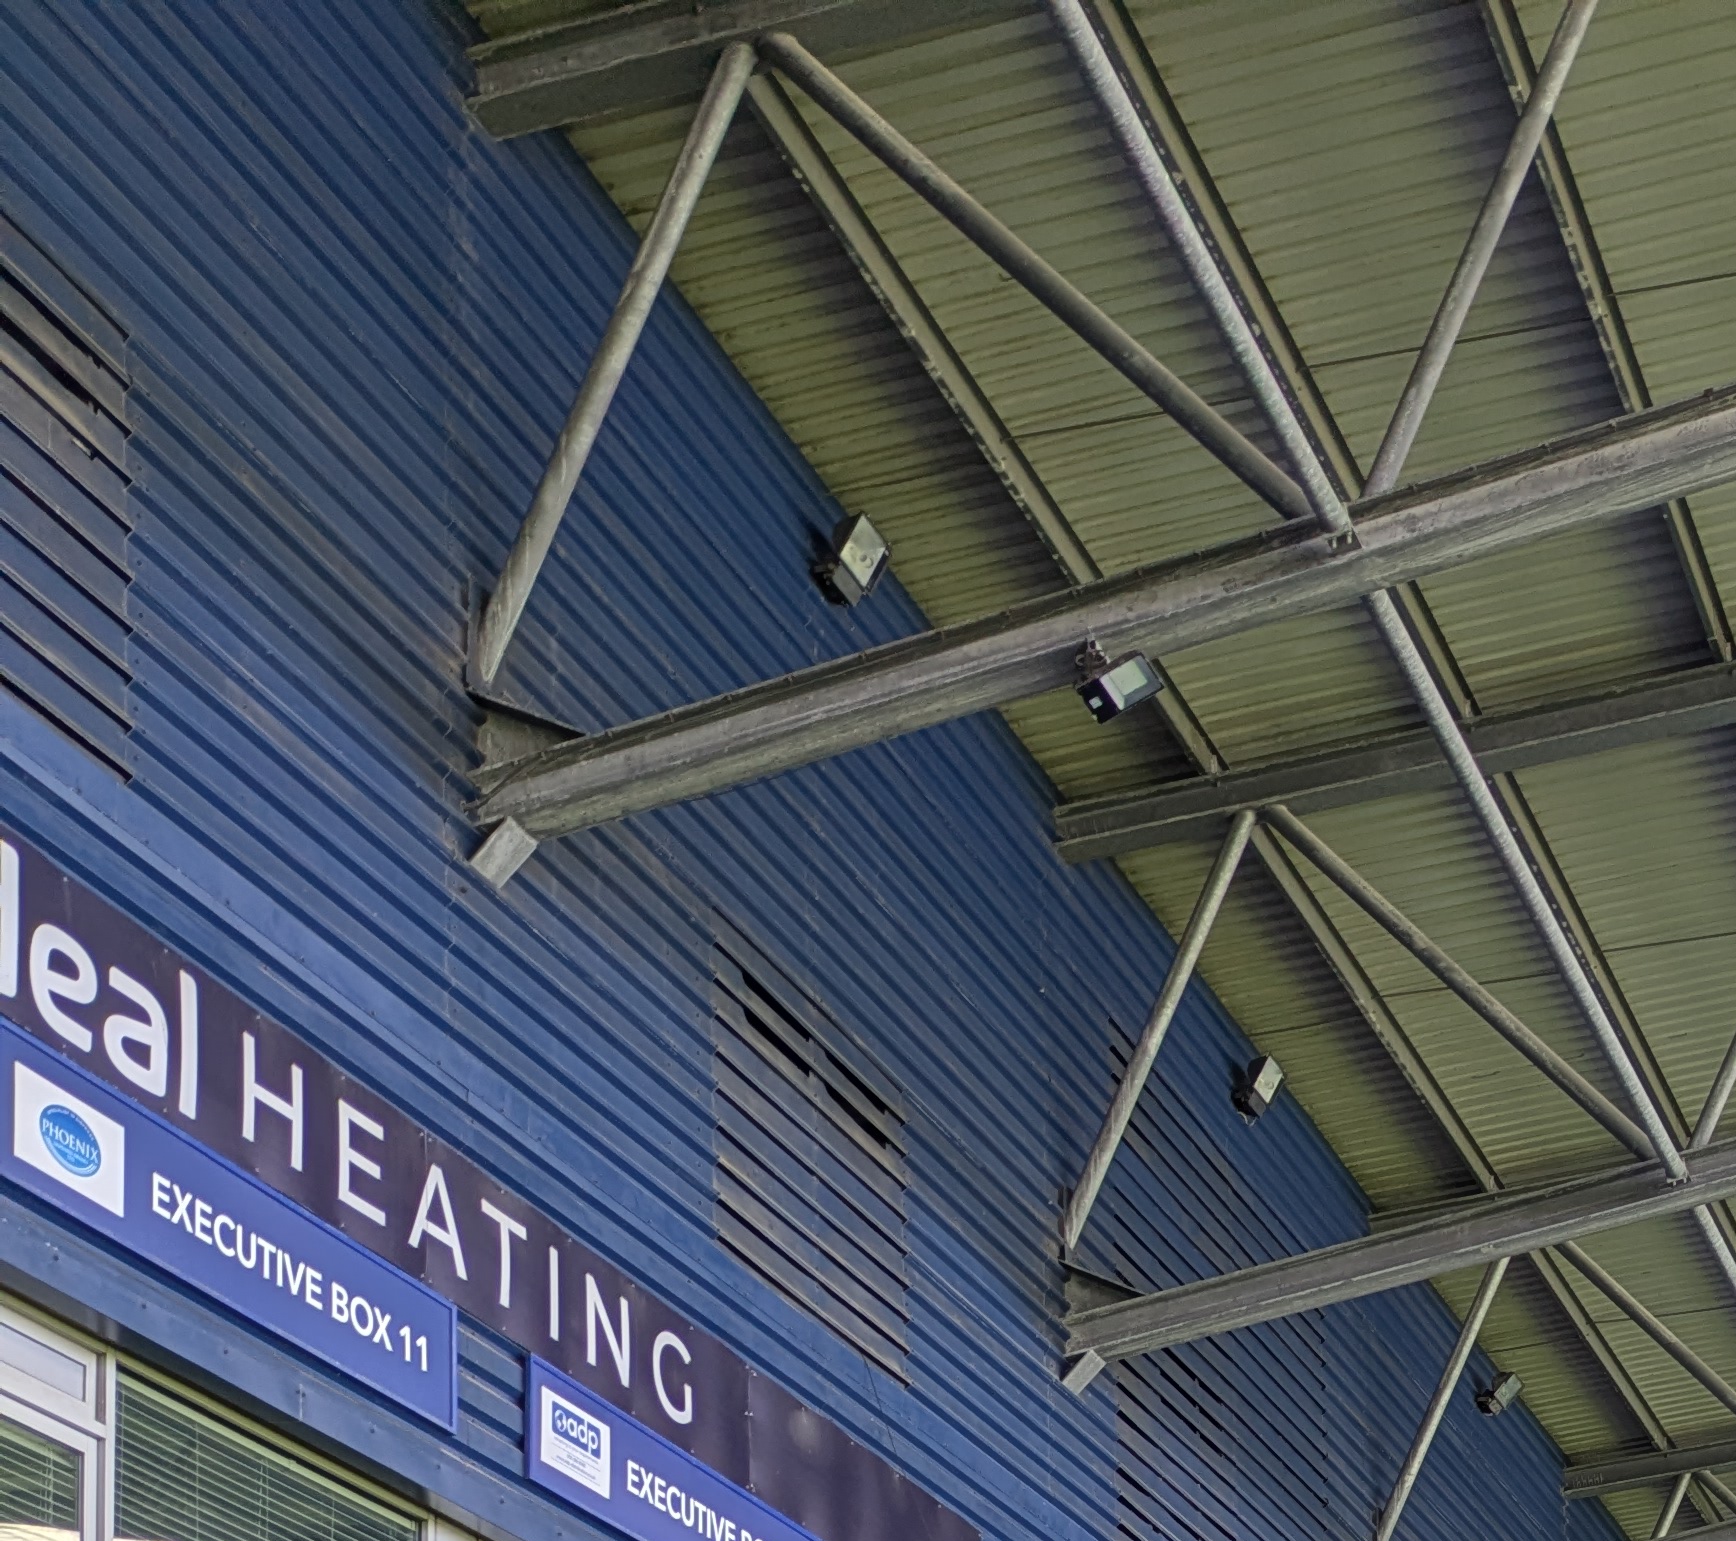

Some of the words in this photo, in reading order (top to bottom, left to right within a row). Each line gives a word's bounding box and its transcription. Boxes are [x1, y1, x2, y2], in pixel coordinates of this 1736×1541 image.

[0, 838, 197, 1120] eal
[241, 1030, 693, 1425] HEATING
[41, 1118, 100, 1165] PHOENIX
[152, 1171, 324, 1310] EXECUTIVE
[331, 1281, 393, 1351] BOX
[399, 1325, 430, 1372] 11
[567, 1417, 599, 1454] adp
